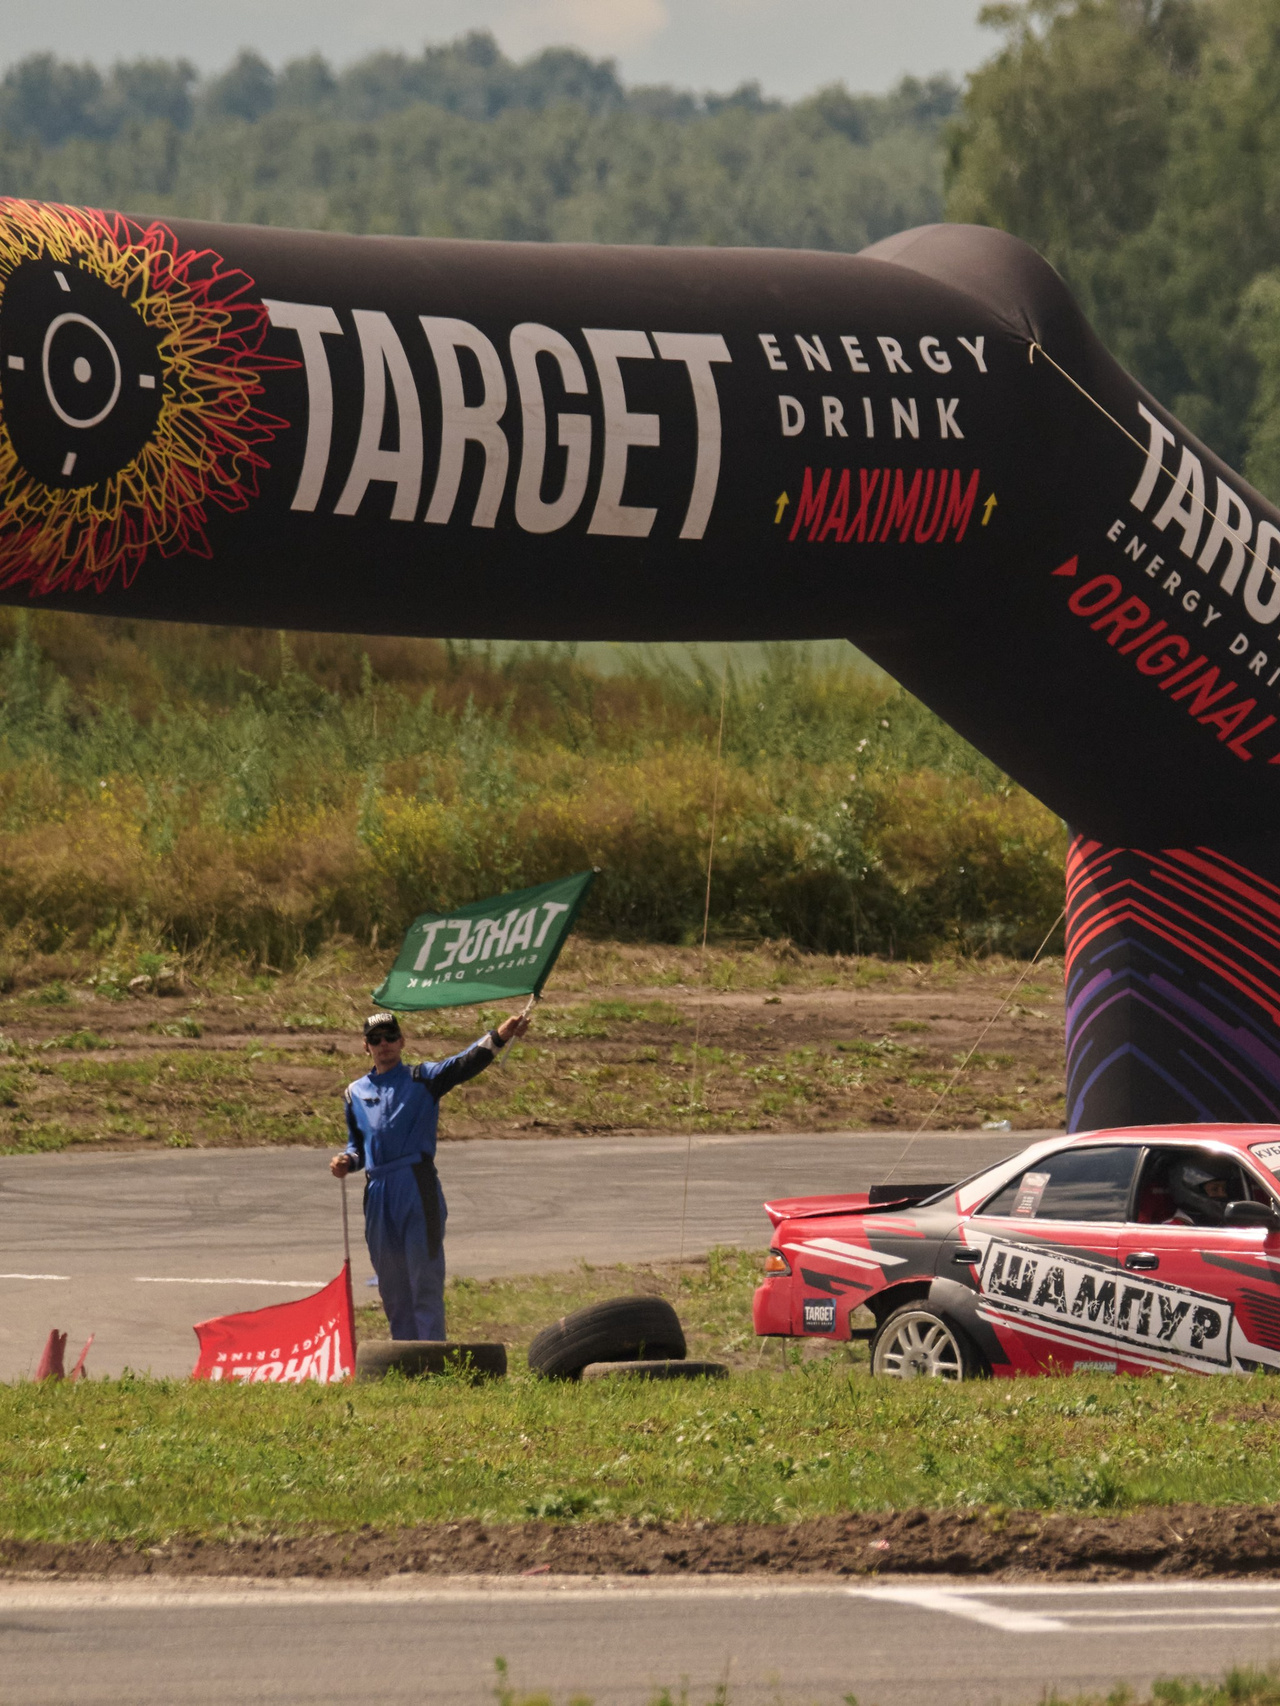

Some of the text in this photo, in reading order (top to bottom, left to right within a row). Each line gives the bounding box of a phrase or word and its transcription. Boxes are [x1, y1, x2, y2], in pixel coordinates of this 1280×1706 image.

[758, 333, 988, 374] ENERGY
[261, 298, 732, 540] TARGET
[778, 395, 965, 439] DRINK
[788, 466, 980, 543] MAXIMUM
[1106, 519, 1222, 628] ENERGY
[1068, 574, 1277, 762] ORIGINAL
[804, 1305, 835, 1321] TARGET
[988, 1251, 1222, 1350] ШАМПУР
[217, 1347, 280, 1362] DRINK
